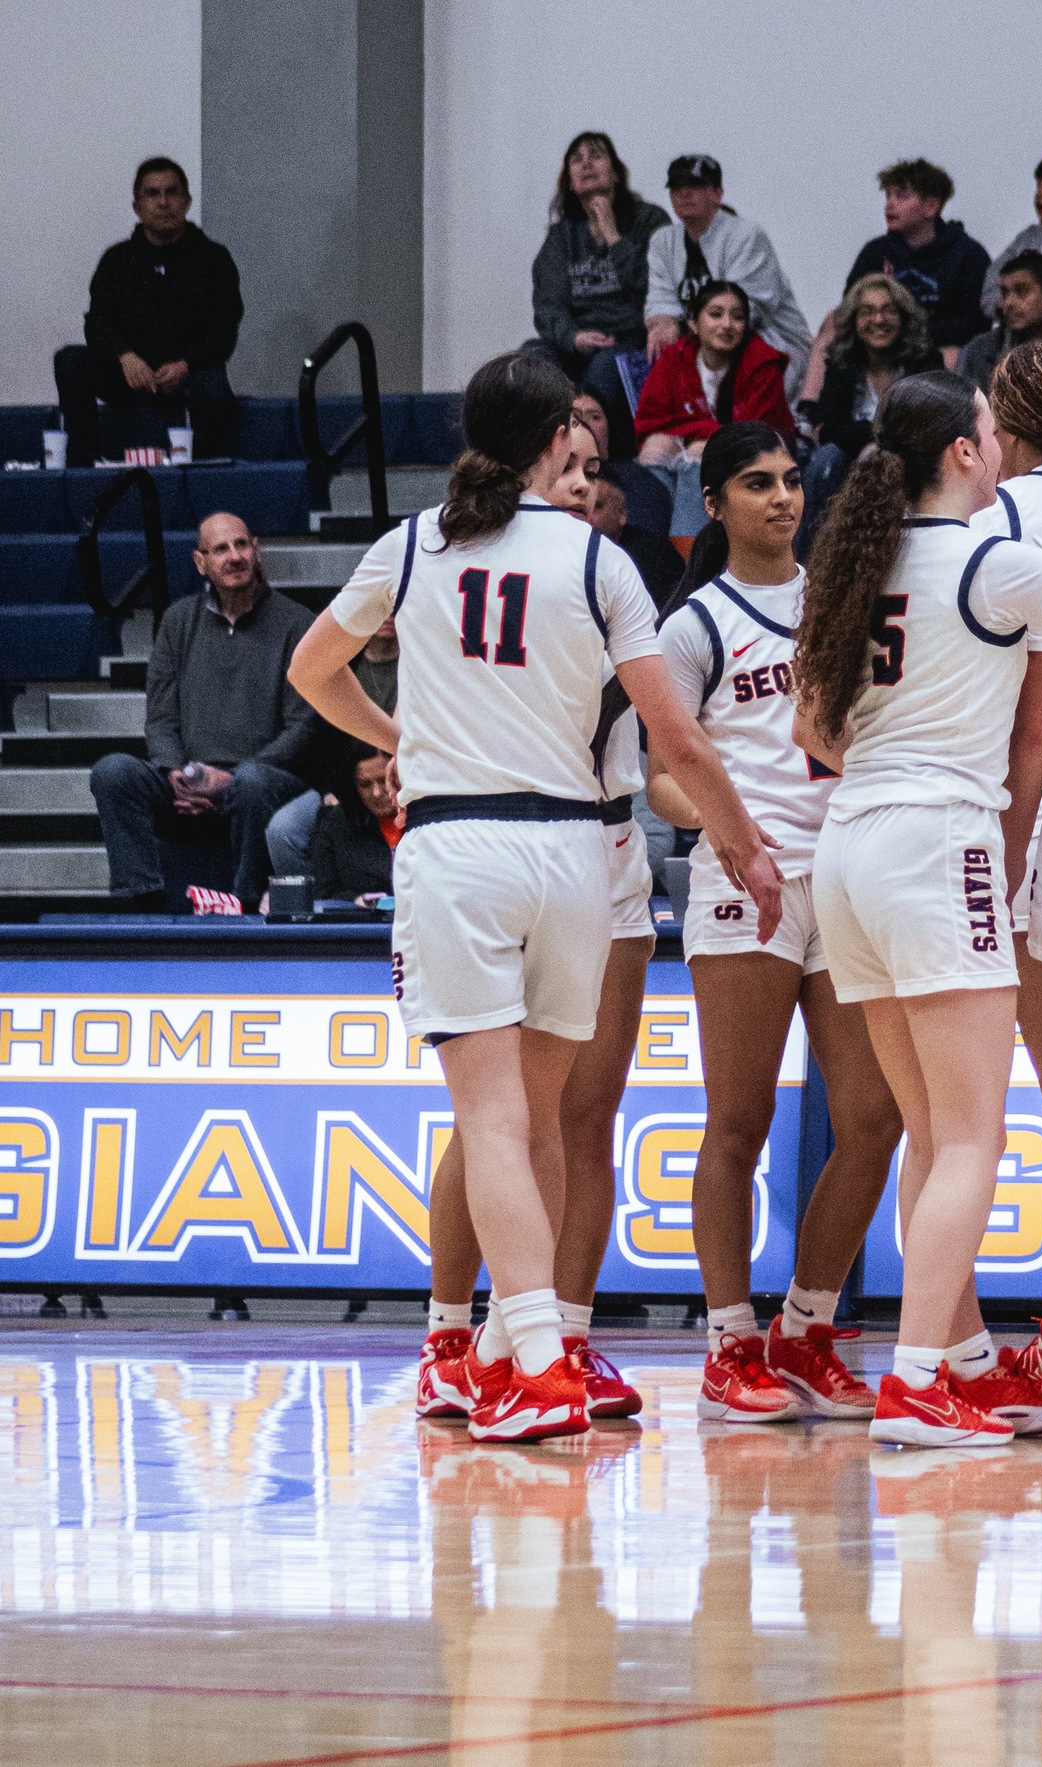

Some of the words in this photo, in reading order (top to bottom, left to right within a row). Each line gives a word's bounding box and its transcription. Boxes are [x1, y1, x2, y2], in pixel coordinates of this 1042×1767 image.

[457, 567, 531, 667] 11
[732, 660, 796, 704] SEQ
[963, 848, 998, 952] GIANTS
[0, 1008, 281, 1068] HOME
[0, 1107, 769, 1270] IANS
